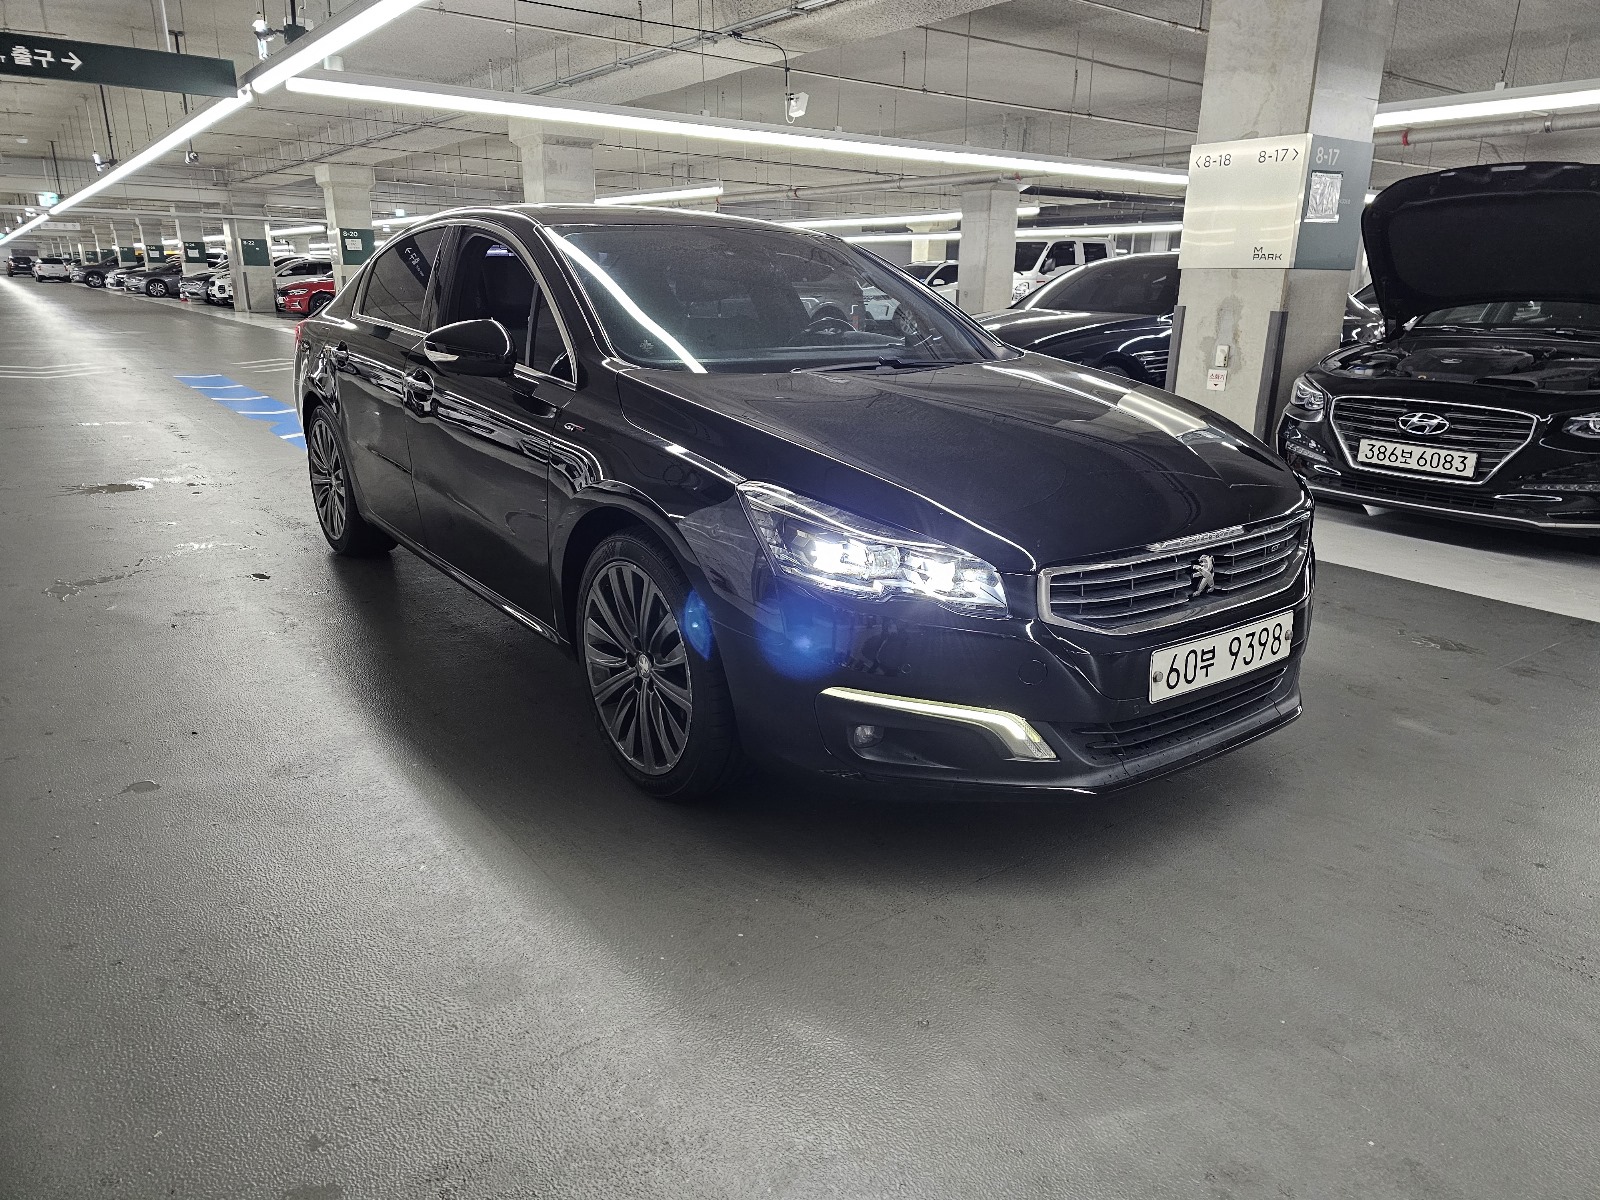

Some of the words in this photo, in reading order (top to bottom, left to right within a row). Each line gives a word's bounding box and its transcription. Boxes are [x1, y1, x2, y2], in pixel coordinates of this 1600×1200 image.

[10, 45, 56, 68] 출구
[1203, 153, 1232, 168] 8-18
[1258, 148, 1289, 164] 8-17
[1315, 146, 1340, 166] 8-17
[1252, 253, 1283, 261] PARK
[1364, 443, 1414, 465] 386보
[1416, 450, 1469, 473] 6083
[1166, 645, 1216, 690] 60부
[1228, 622, 1283, 672] 9398
